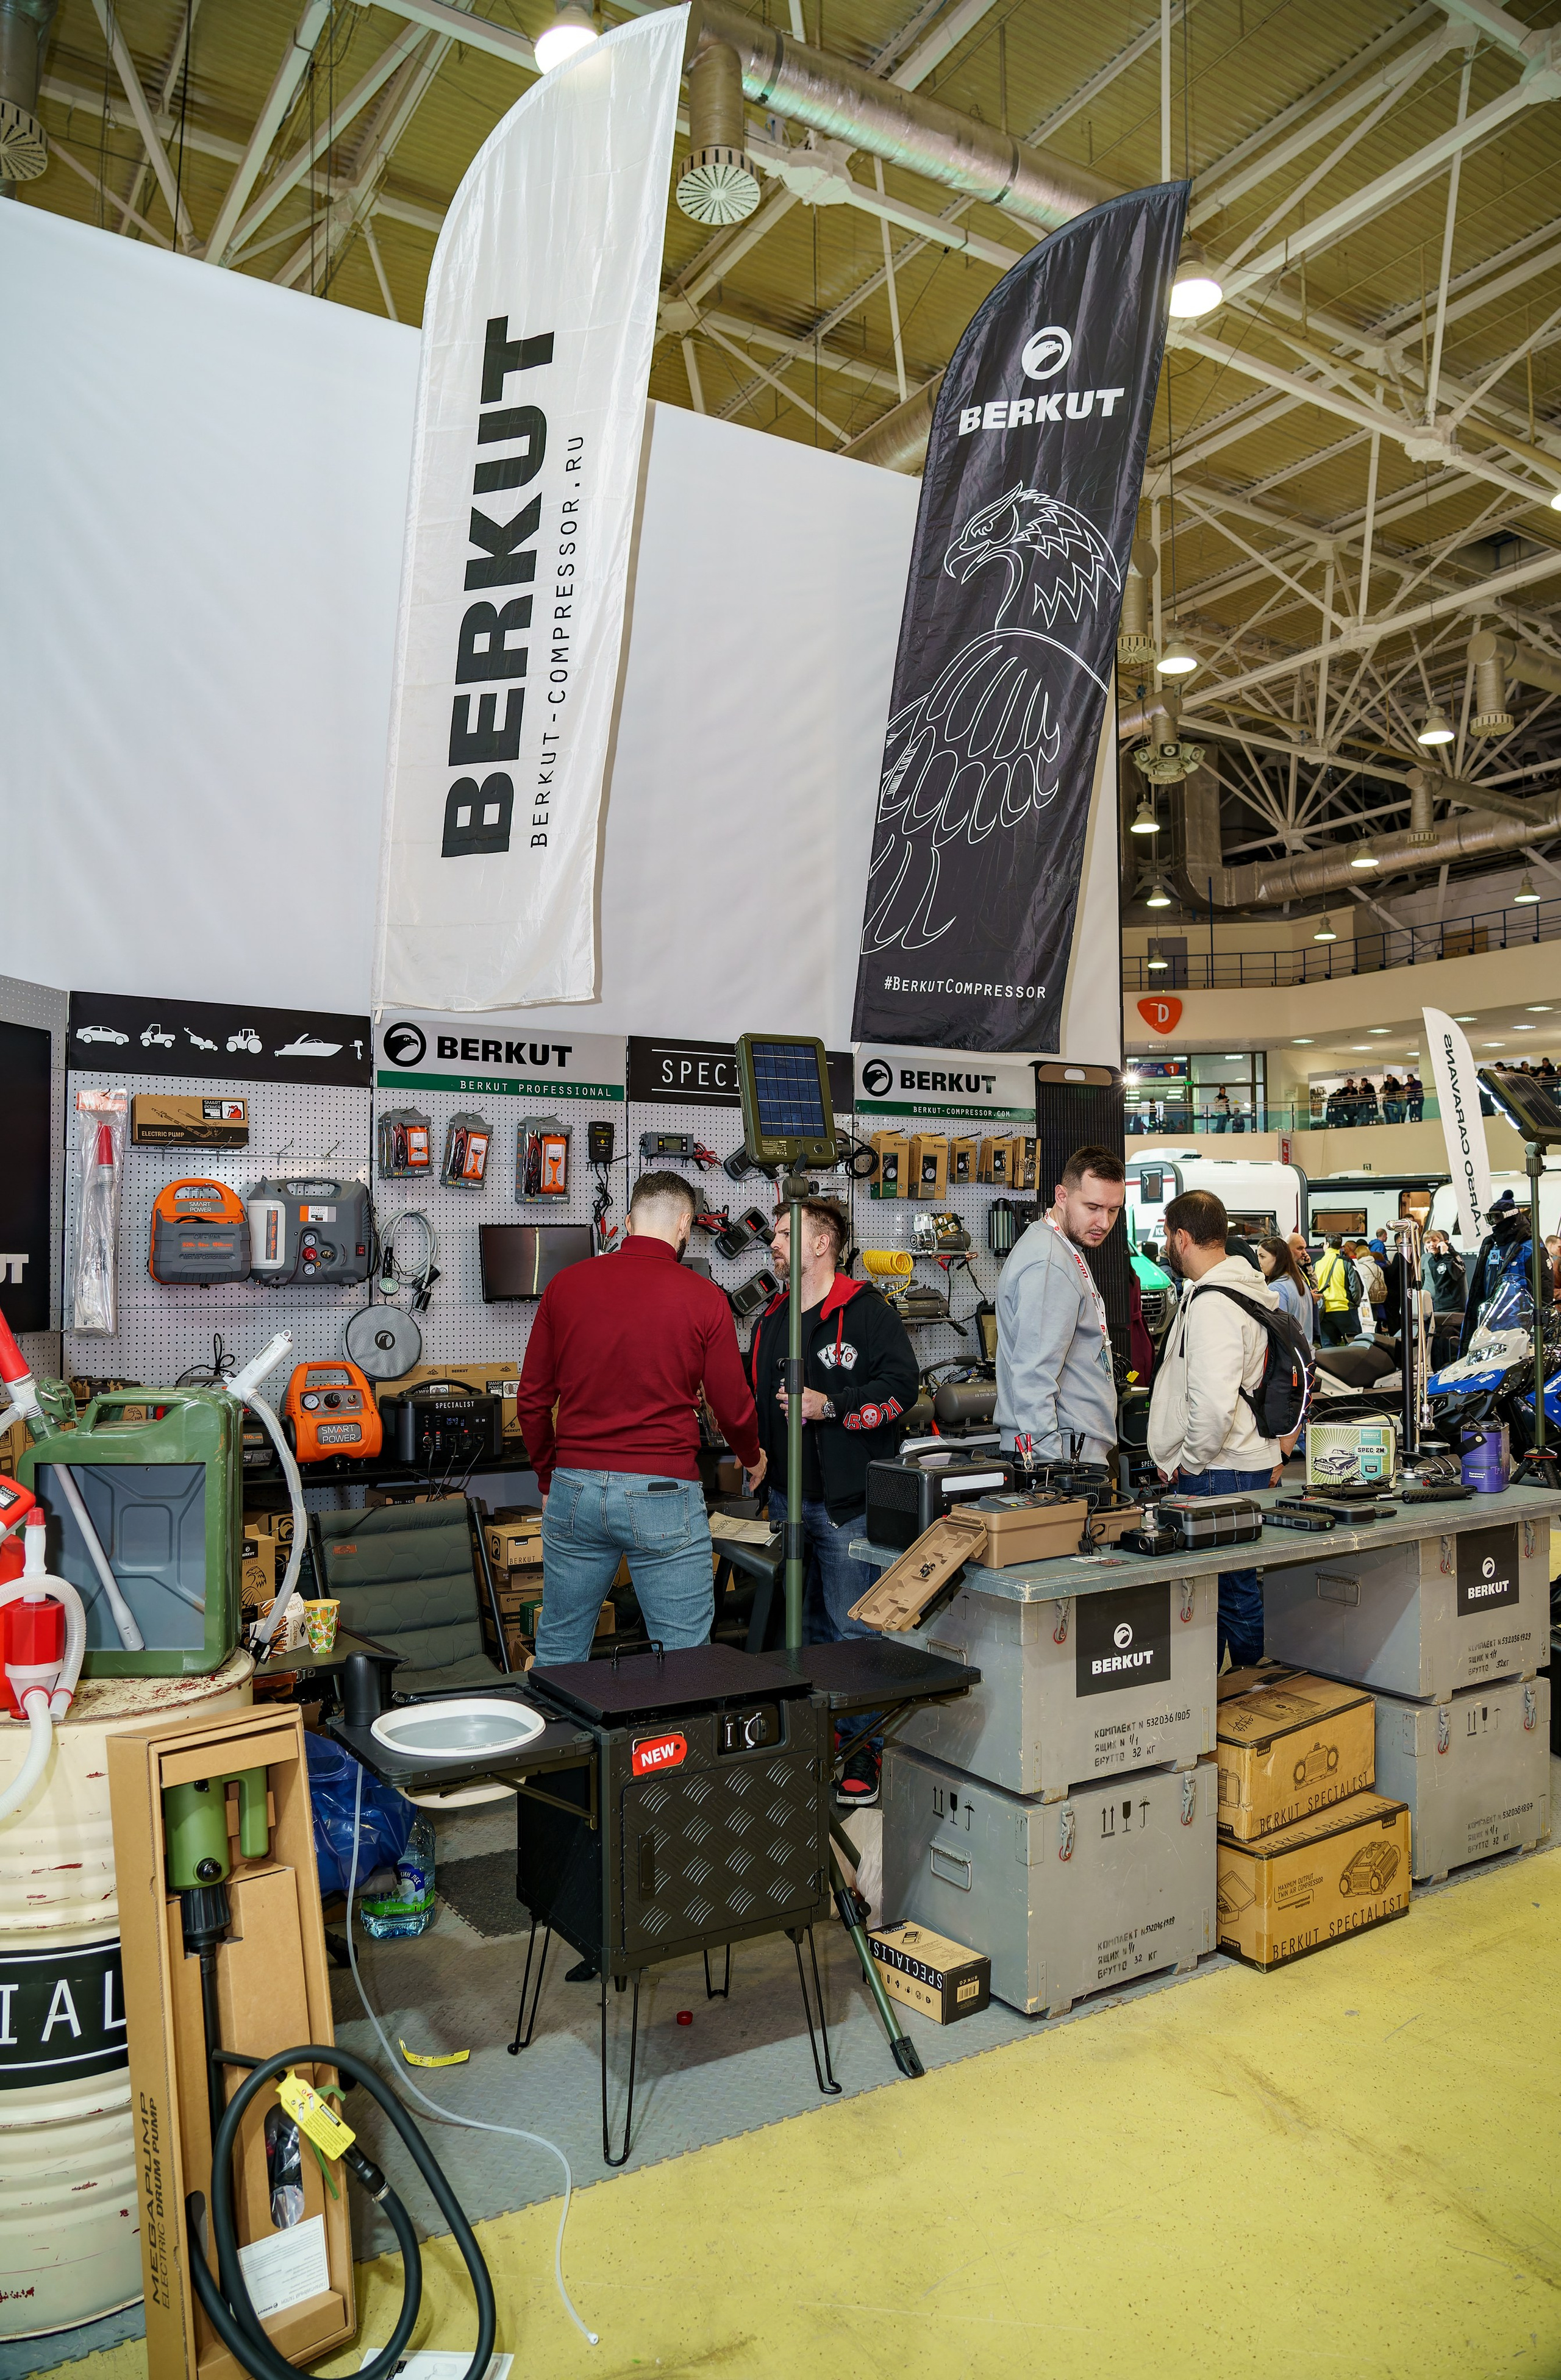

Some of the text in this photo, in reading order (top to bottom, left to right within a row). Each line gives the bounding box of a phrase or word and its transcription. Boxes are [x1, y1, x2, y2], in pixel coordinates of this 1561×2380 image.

[959, 388, 1124, 436] BERKUT
[441, 315, 554, 858] BERKUT
[530, 436, 584, 848] BERKUT-COMPRESSOR.RU
[437, 1036, 573, 1068] BERKUT
[460, 1080, 612, 1097] BERKUT PROFESSIONAL
[900, 1069, 996, 1095] BERKUT
[913, 1105, 1010, 1117] BERKUT-COMPRESSOR.COM
[321, 1425, 354, 1434] SMART
[322, 1434, 355, 1444] POWER
[509, 1556, 536, 1565] BERKUT
[1468, 1580, 1509, 1599] BERKUT
[1092, 1650, 1153, 1675] BERKUT
[641, 1742, 674, 1767] NEW
[1259, 1771, 1368, 1833] BERKUT SPECIALIST
[1259, 1801, 1395, 1852] BERKUT SPECIALIST
[1278, 1873, 1313, 1892] MAXIMUM OUTPUT
[1278, 1889, 1288, 1899] TWIN
[1298, 1876, 1323, 1891] COMPRESSOR
[1273, 1894, 1402, 1960] BERKUT SPECIALIST
[140, 2091, 162, 2306] MEGAPUMP
[149, 2097, 171, 2309] ELECTRIC DRUM PUMP
